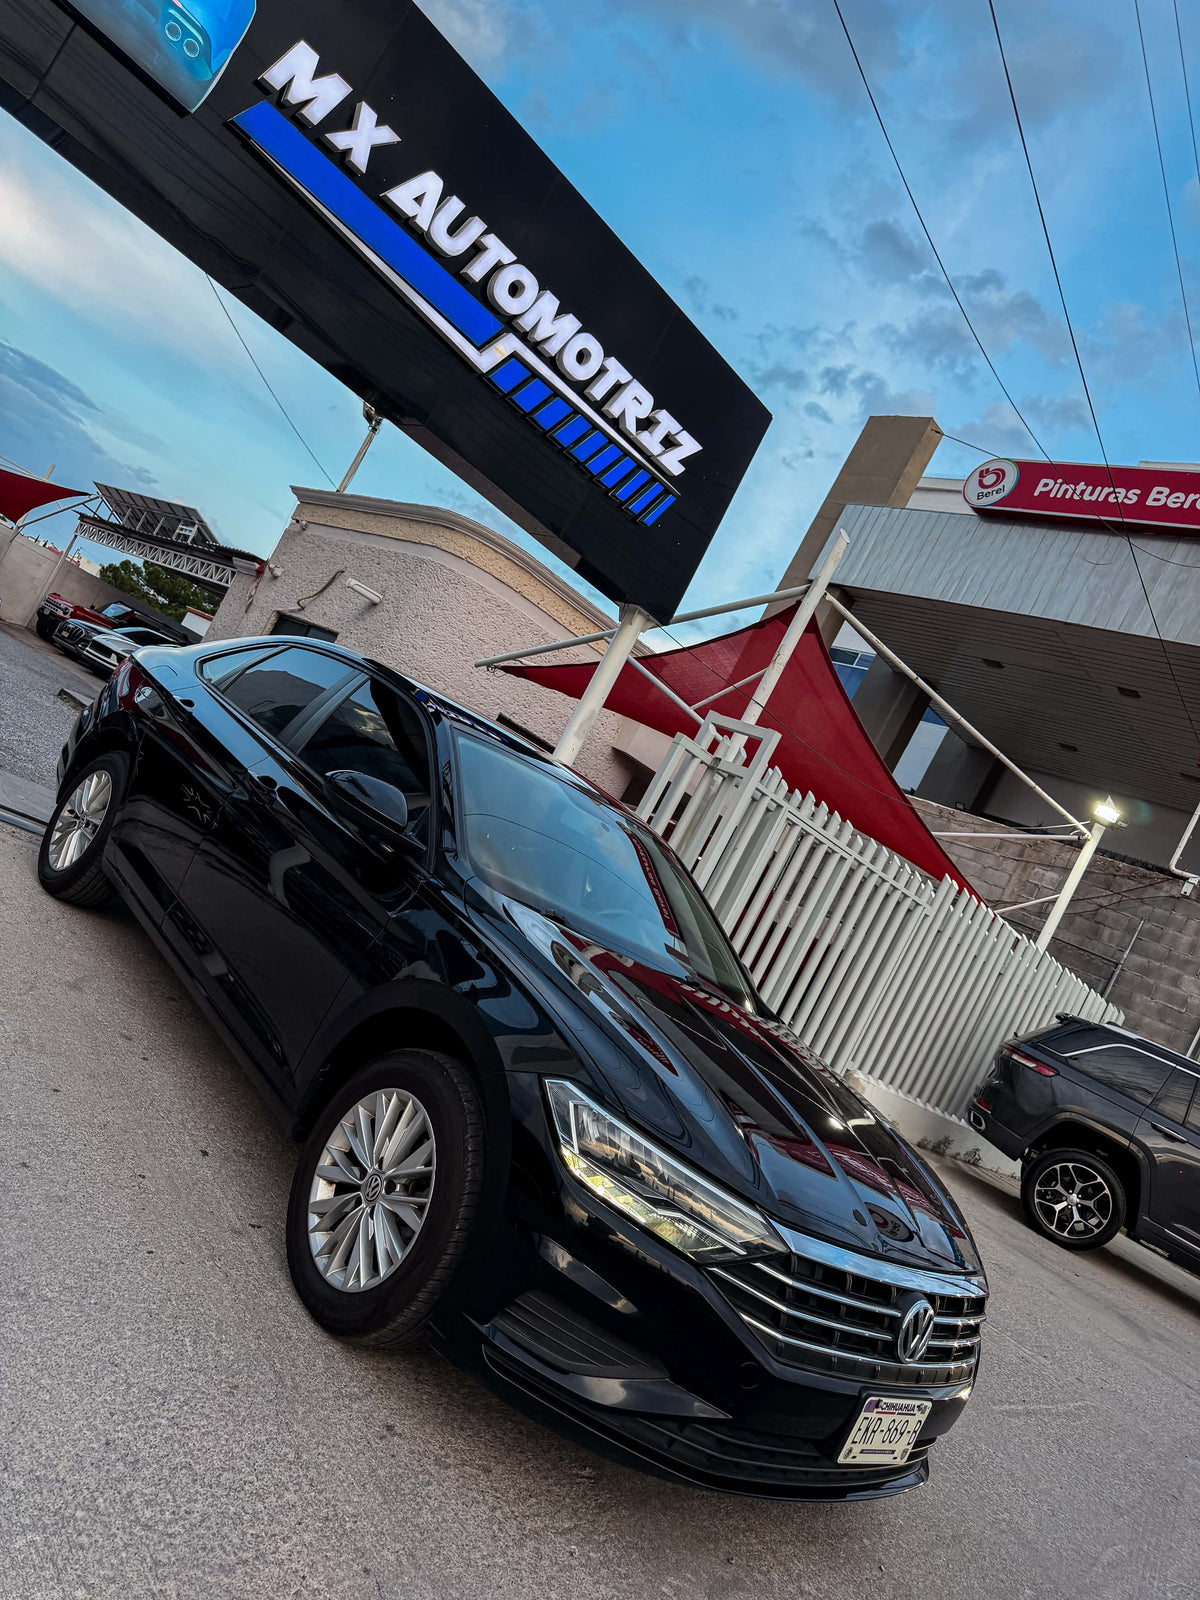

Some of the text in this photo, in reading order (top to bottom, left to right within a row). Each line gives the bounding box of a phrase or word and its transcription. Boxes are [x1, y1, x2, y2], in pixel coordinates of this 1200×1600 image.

[258, 40, 703, 477] MX AUTOMOTRIZ
[977, 484, 1005, 501] Berel
[1033, 478, 1200, 511] Pinturas Ber
[881, 1402, 917, 1412] CHIHUAHUA
[850, 1416, 923, 1446] EKR-869-B
